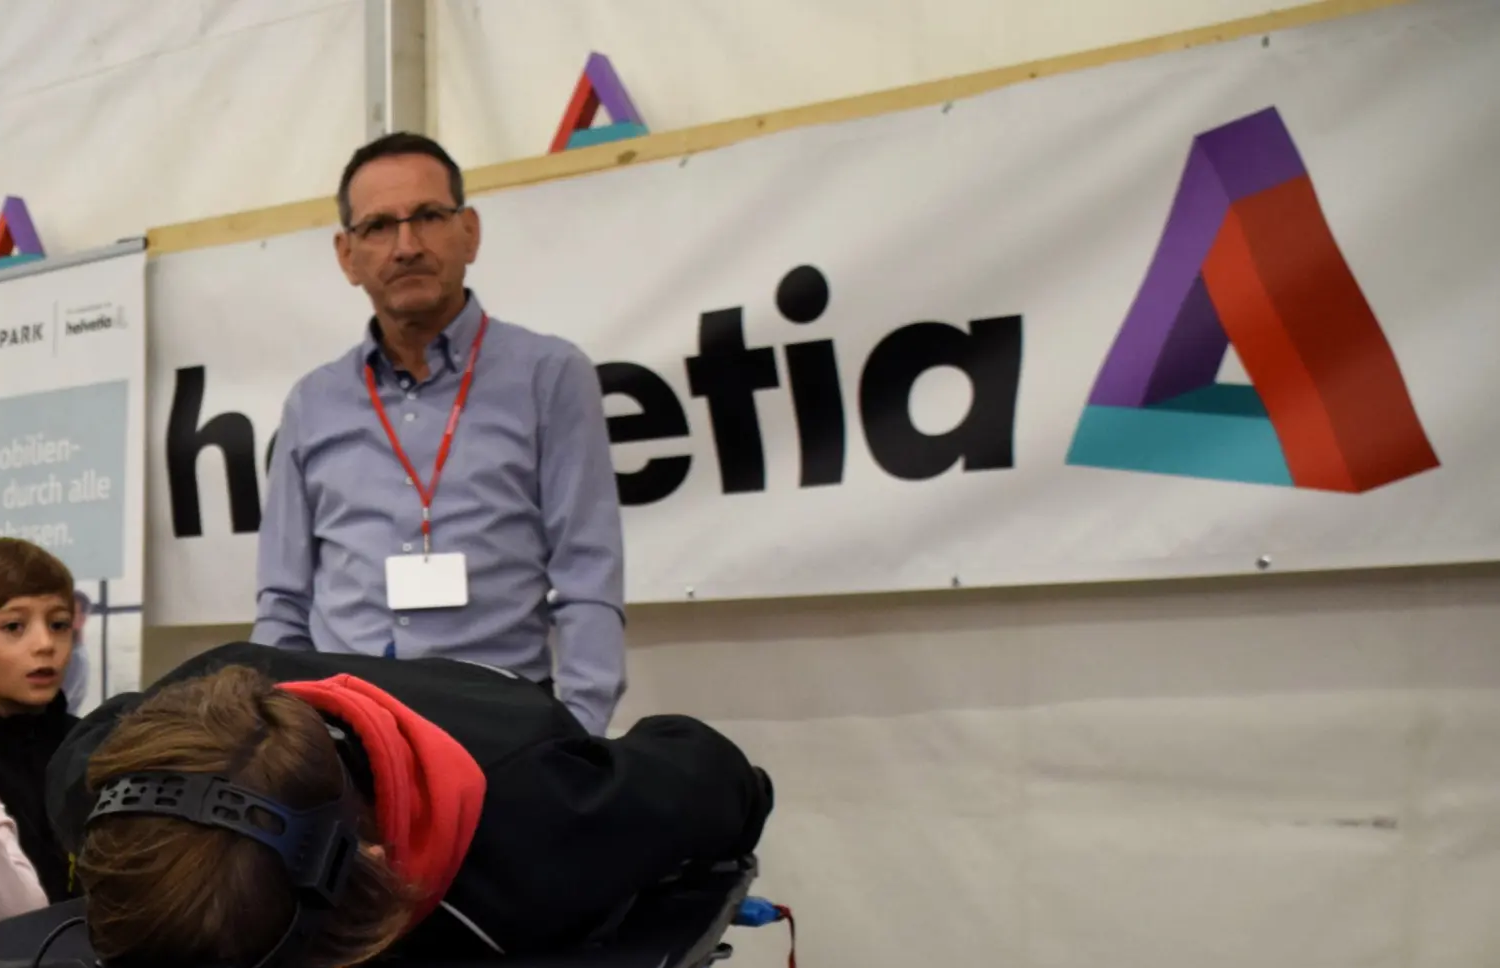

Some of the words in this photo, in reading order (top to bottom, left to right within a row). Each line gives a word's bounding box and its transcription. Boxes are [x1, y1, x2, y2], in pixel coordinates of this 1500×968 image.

[166, 264, 1024, 540] hetia
[2, 473, 63, 510] durch
[67, 468, 112, 504] alle
